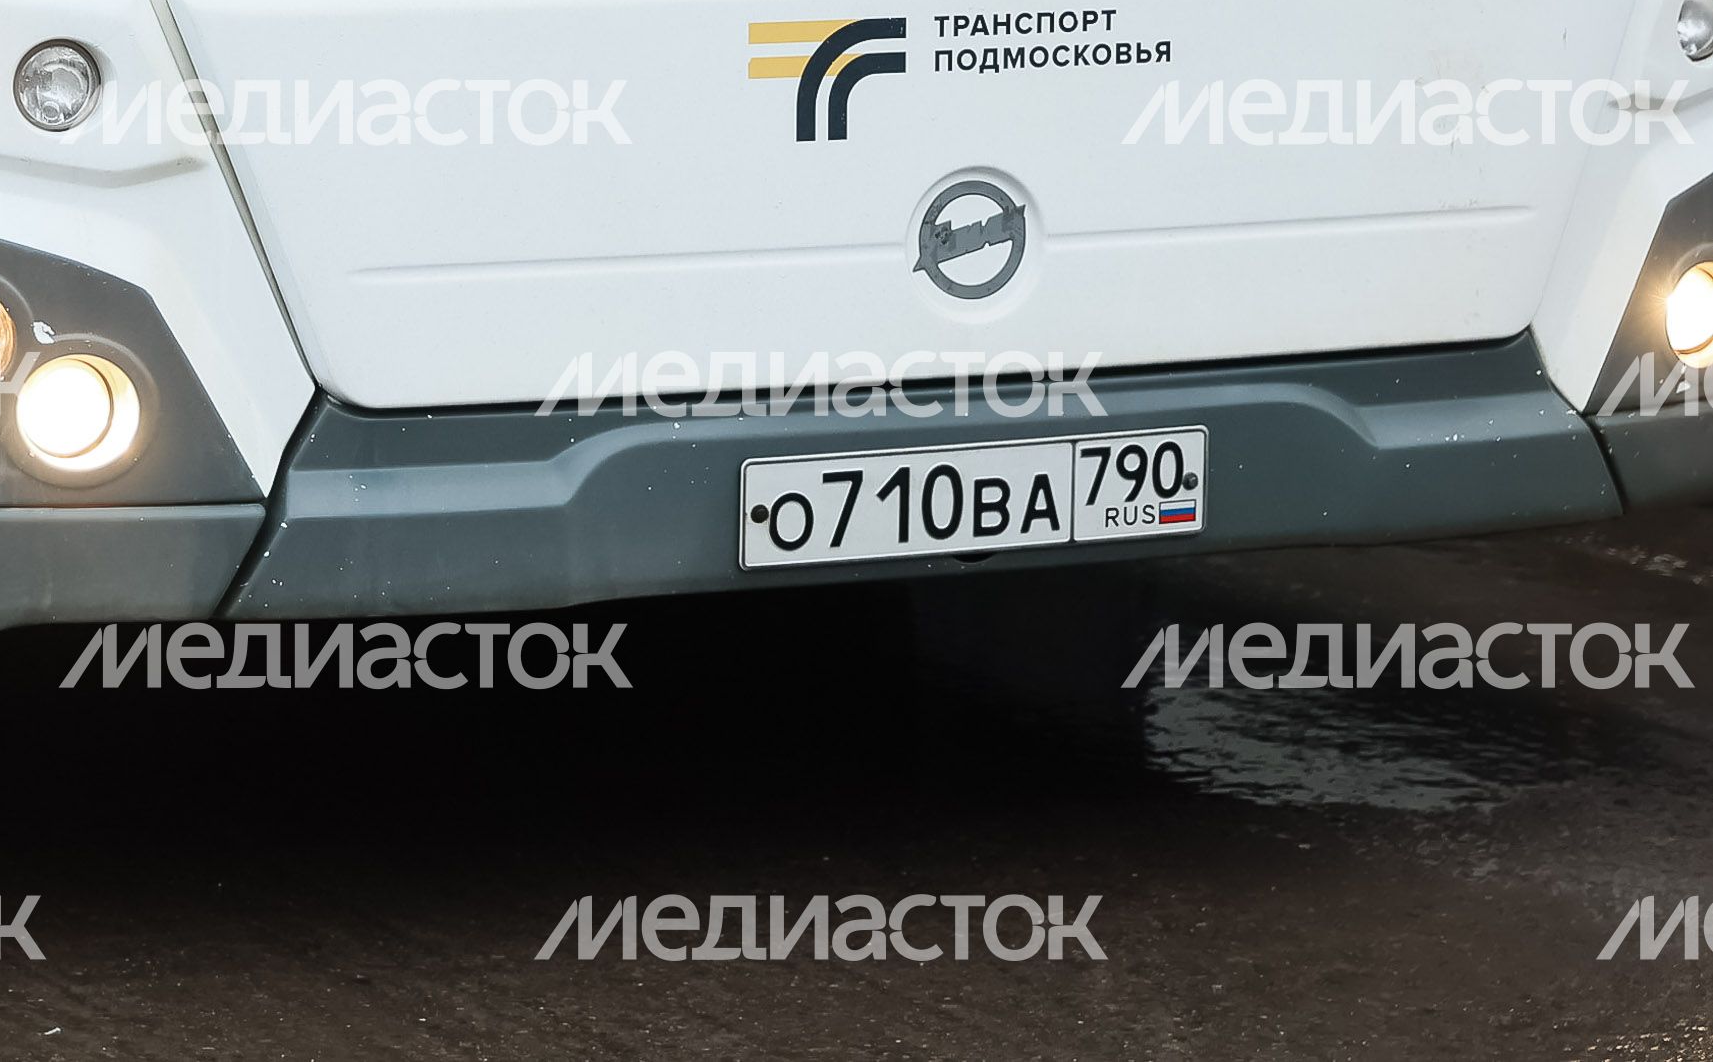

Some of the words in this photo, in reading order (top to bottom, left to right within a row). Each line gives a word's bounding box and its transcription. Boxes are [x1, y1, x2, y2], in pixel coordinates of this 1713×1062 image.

[934, 9, 1117, 38] ТРАНСПОРТ
[934, 40, 1172, 74] ПОДМОСКОВЬЯ
[1079, 440, 1185, 507] 790
[1104, 504, 1156, 528] RUS
